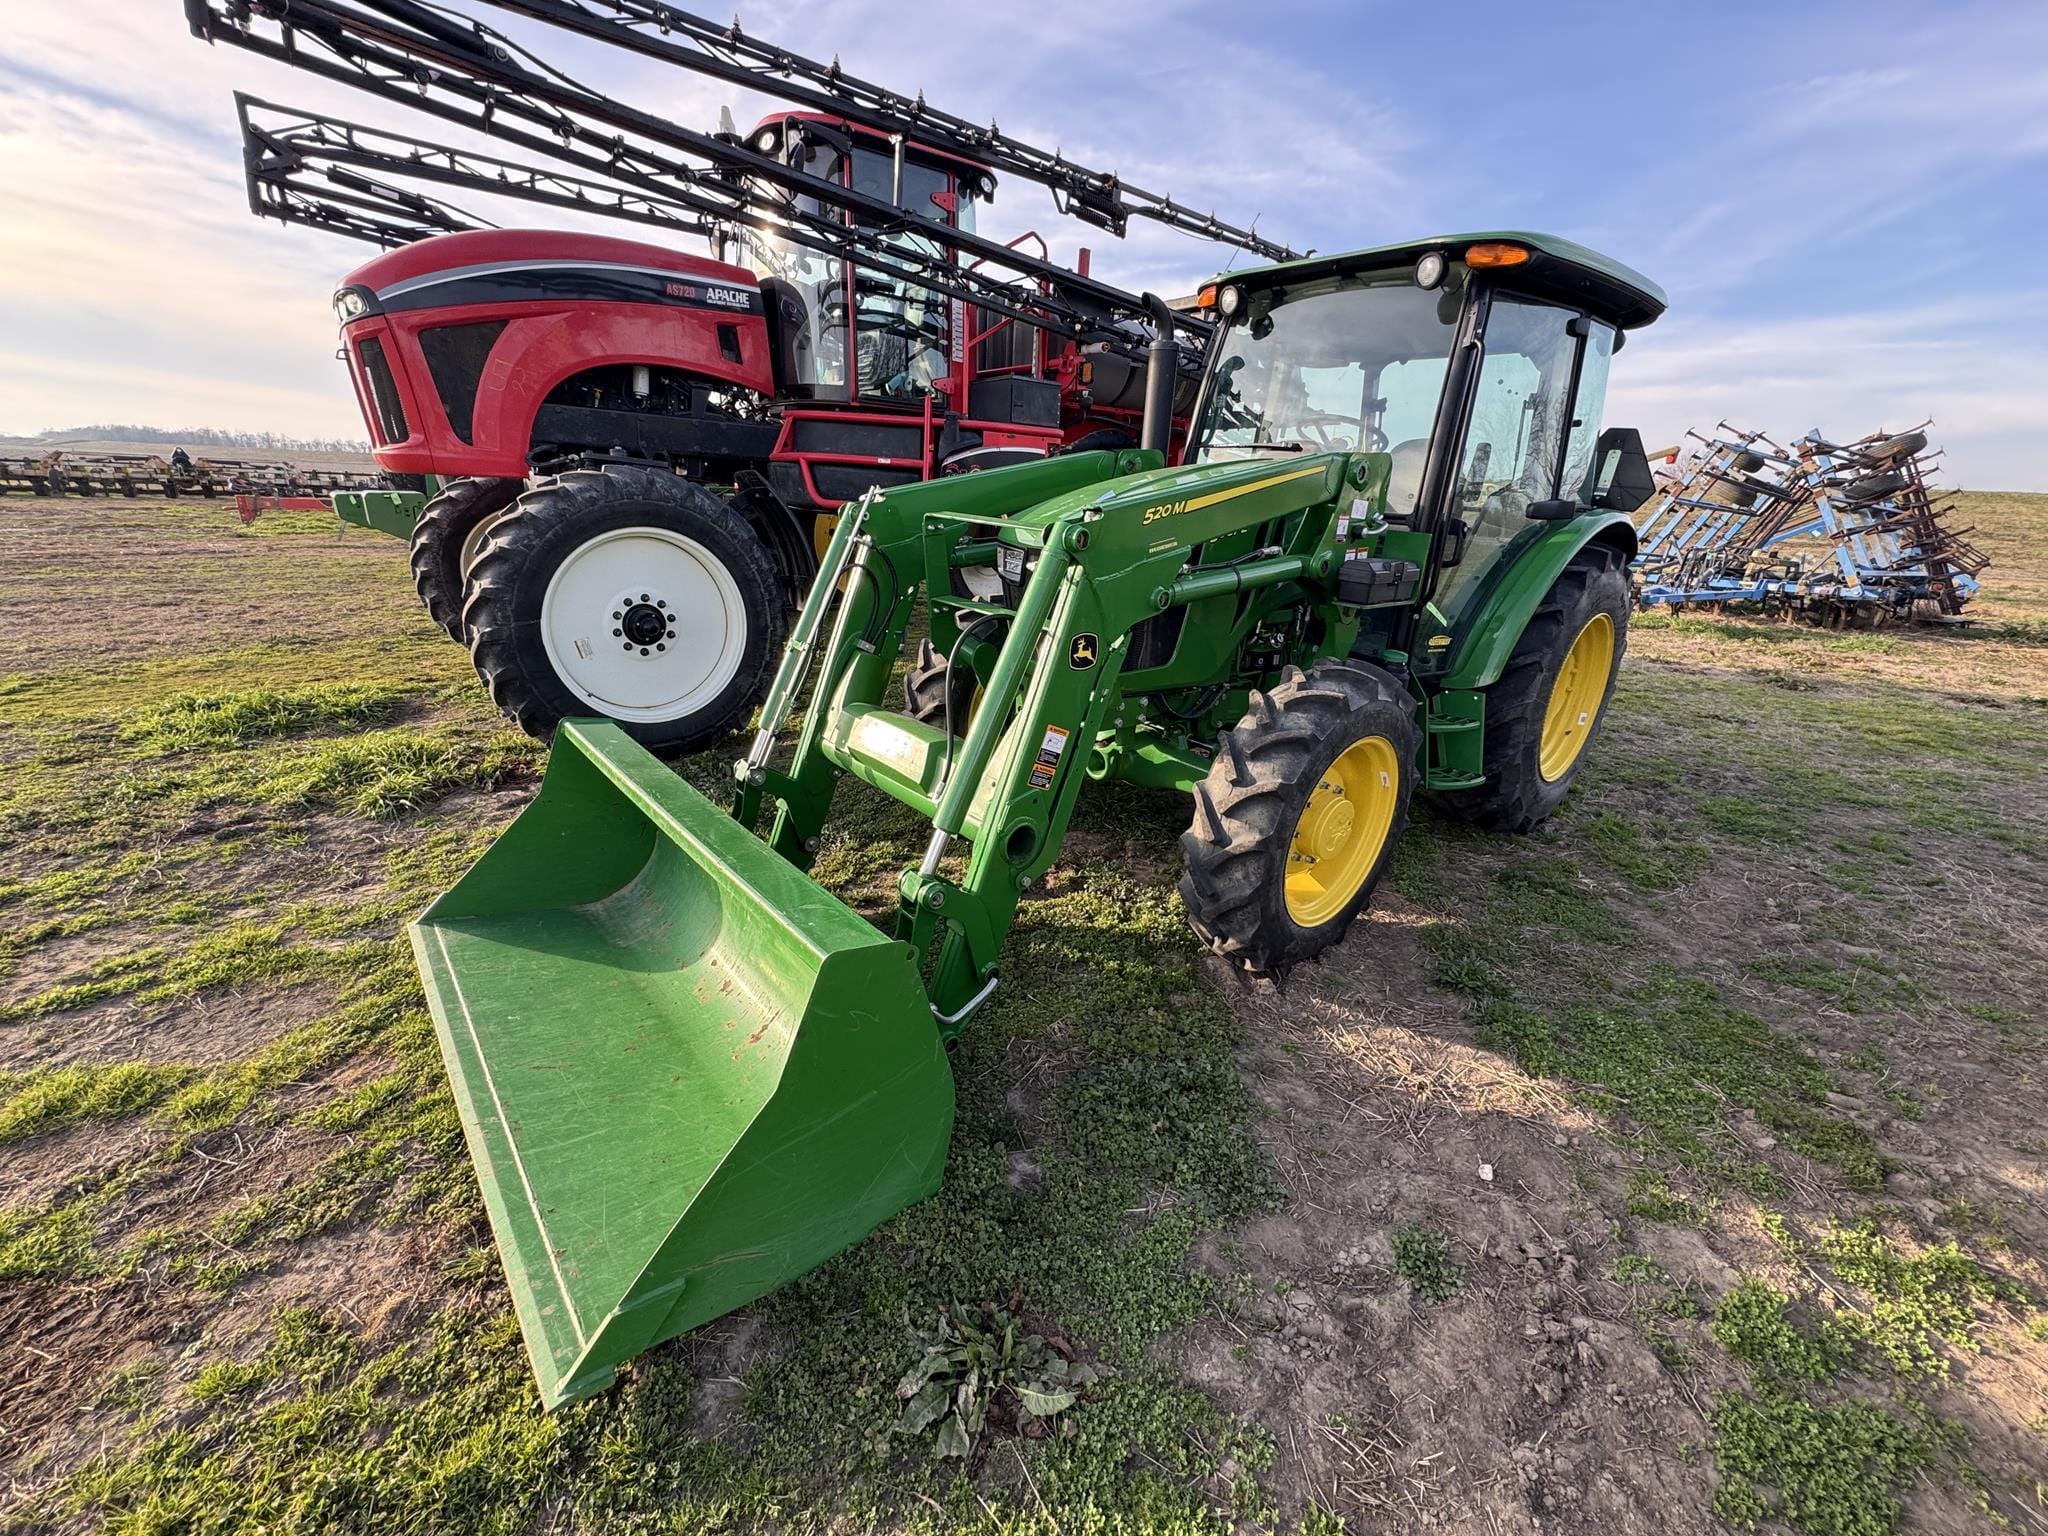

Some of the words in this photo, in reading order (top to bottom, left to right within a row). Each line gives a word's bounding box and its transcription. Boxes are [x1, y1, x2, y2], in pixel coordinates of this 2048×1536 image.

[666, 283, 696, 298] AS720
[706, 287, 750, 305] APACHE
[1142, 500, 1186, 525] 520M
